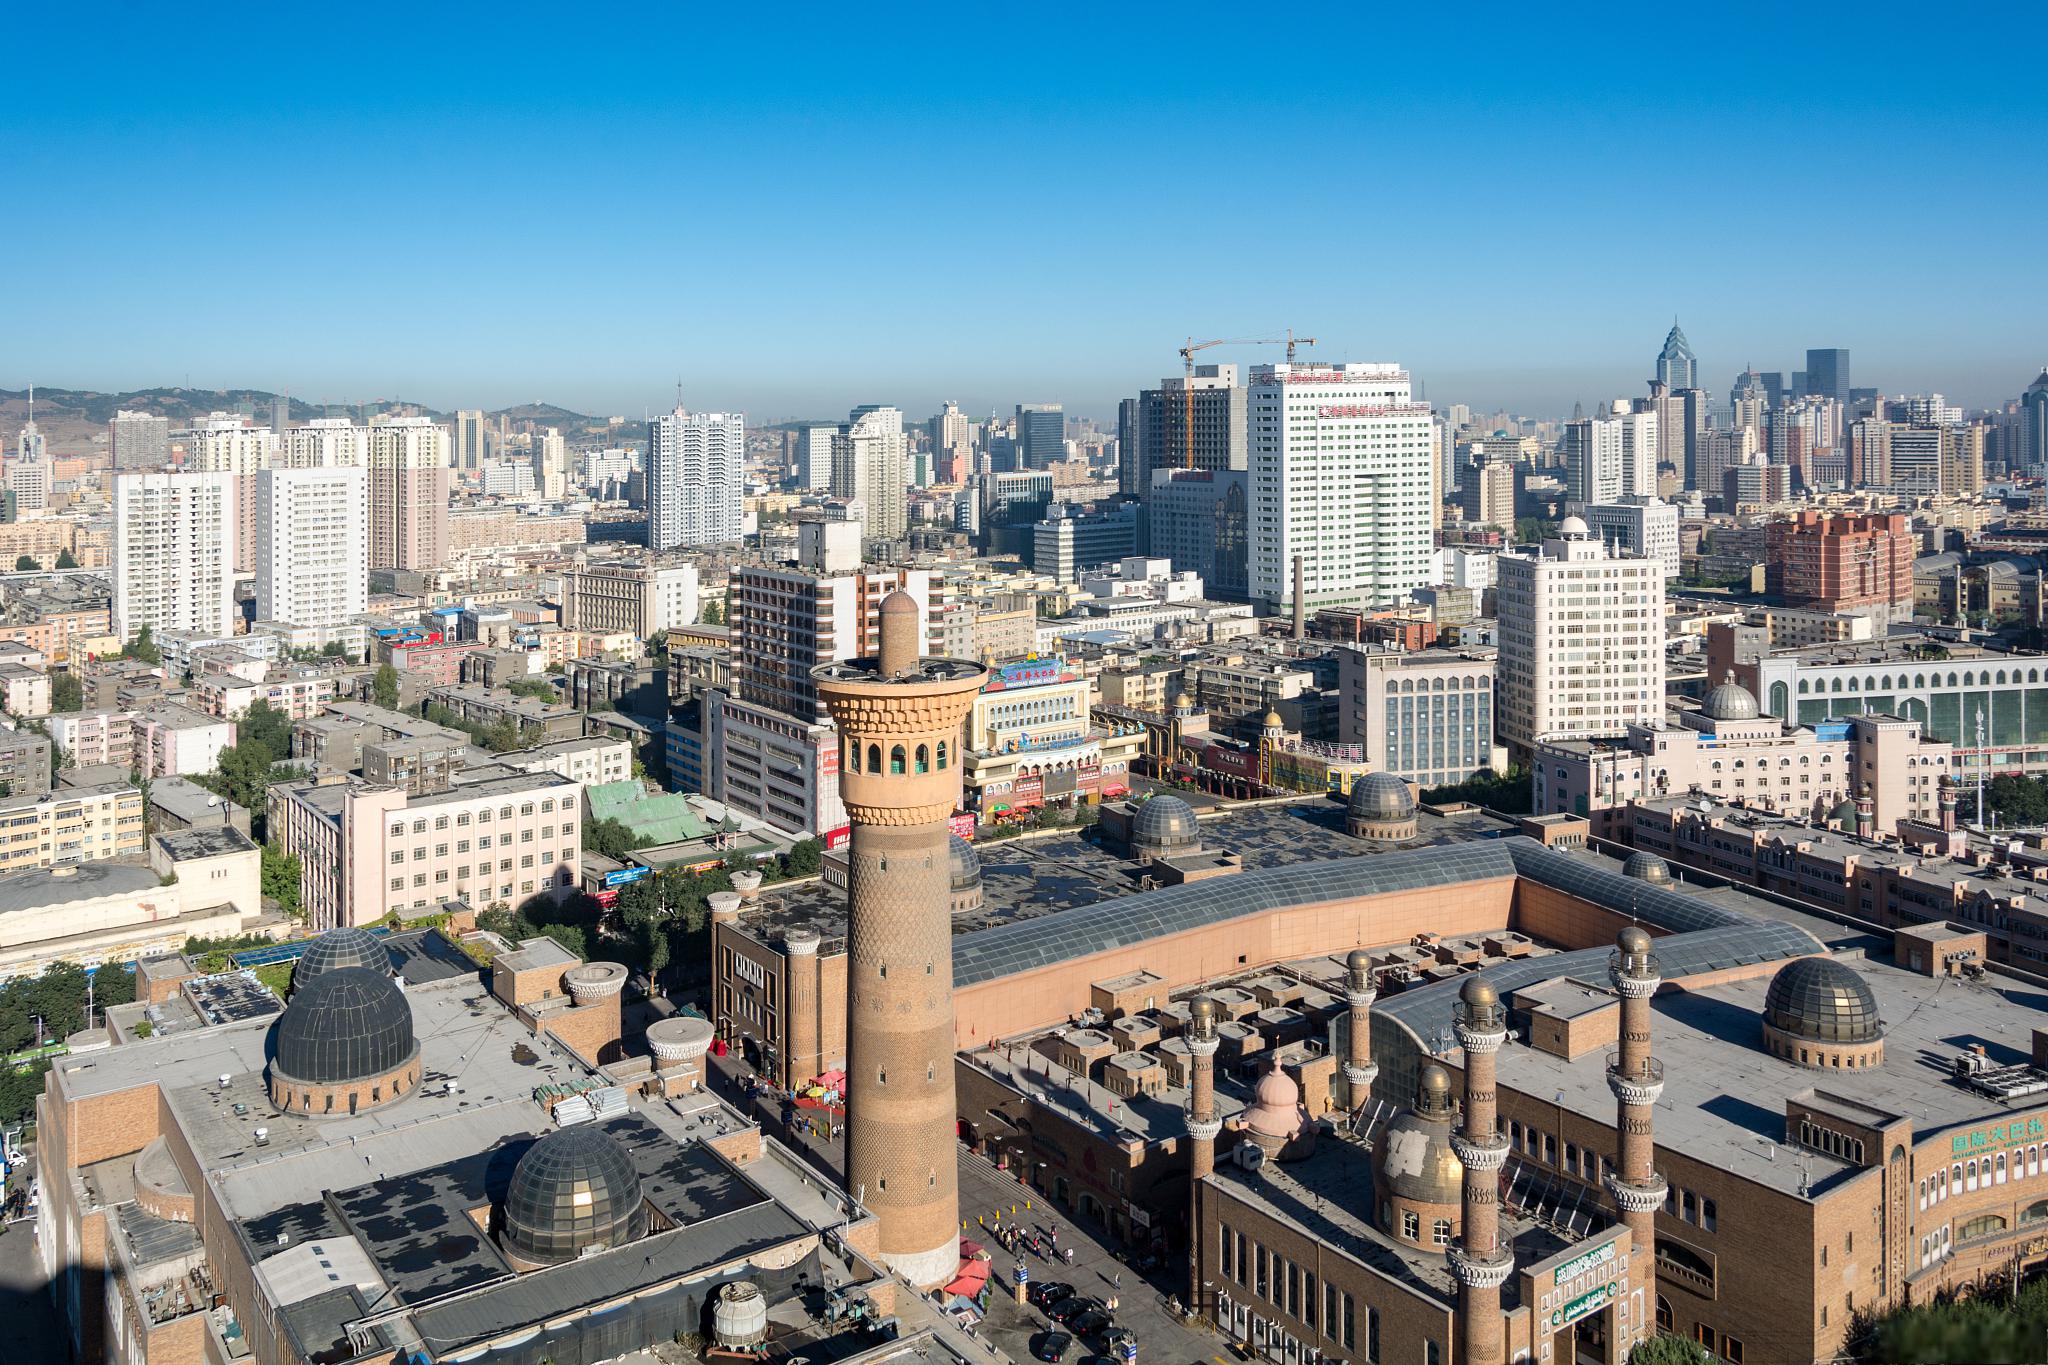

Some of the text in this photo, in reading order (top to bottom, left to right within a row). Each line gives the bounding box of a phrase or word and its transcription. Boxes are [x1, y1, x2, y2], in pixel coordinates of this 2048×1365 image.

[1952, 1118, 2045, 1152] 国际大巴扎
